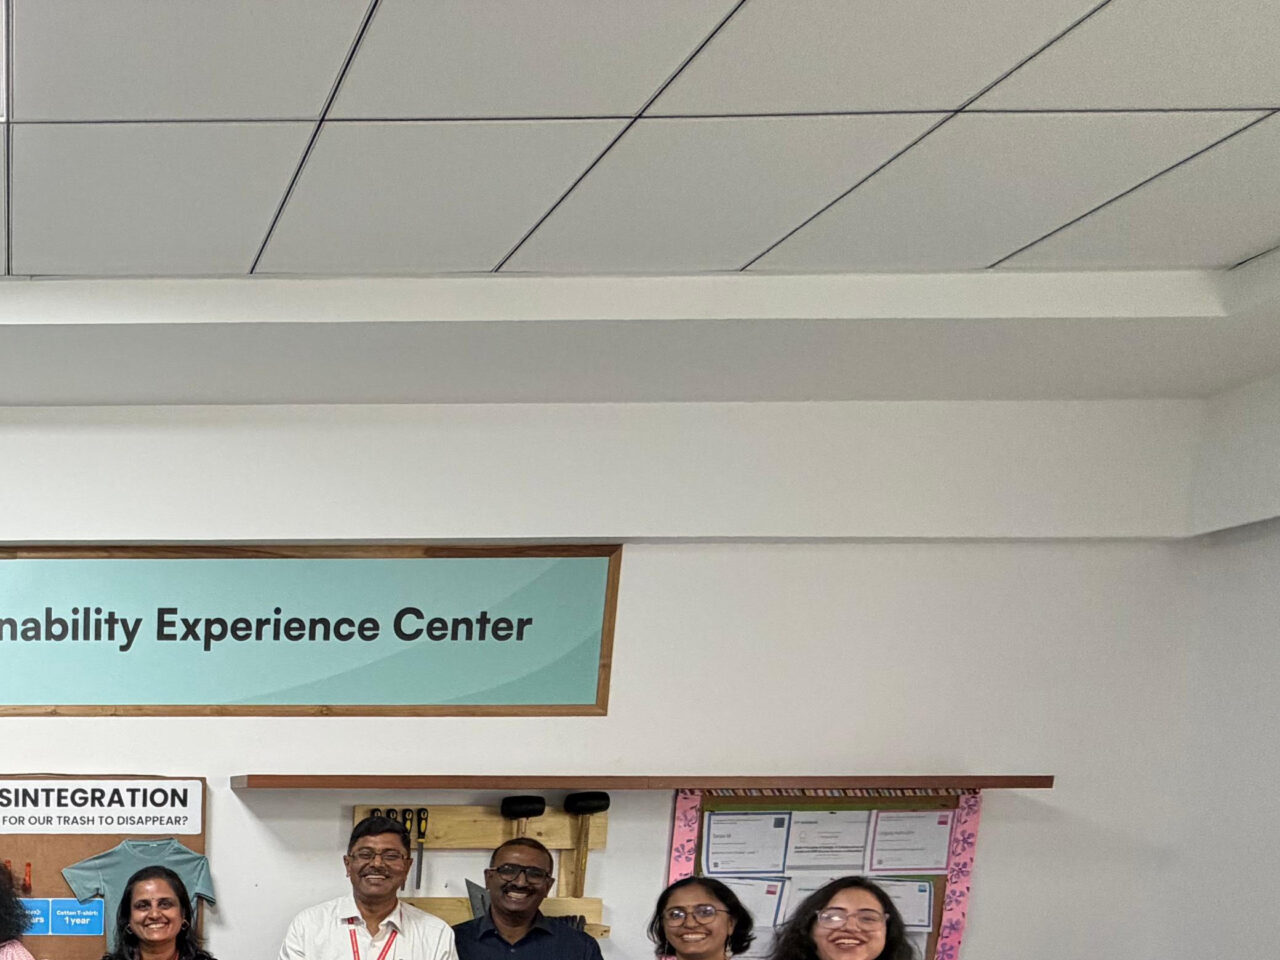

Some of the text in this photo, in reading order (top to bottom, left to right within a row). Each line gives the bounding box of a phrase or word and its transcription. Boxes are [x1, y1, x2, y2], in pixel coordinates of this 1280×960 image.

[157, 607, 380, 652] Experience
[393, 607, 533, 643] Center
[2, 816, 25, 826] FOR
[28, 816, 53, 826] OUR
[56, 816, 95, 826] TRASH
[97, 816, 115, 826] TO
[117, 816, 189, 827] DISAPPEAR?
[70, 917, 91, 926] year
